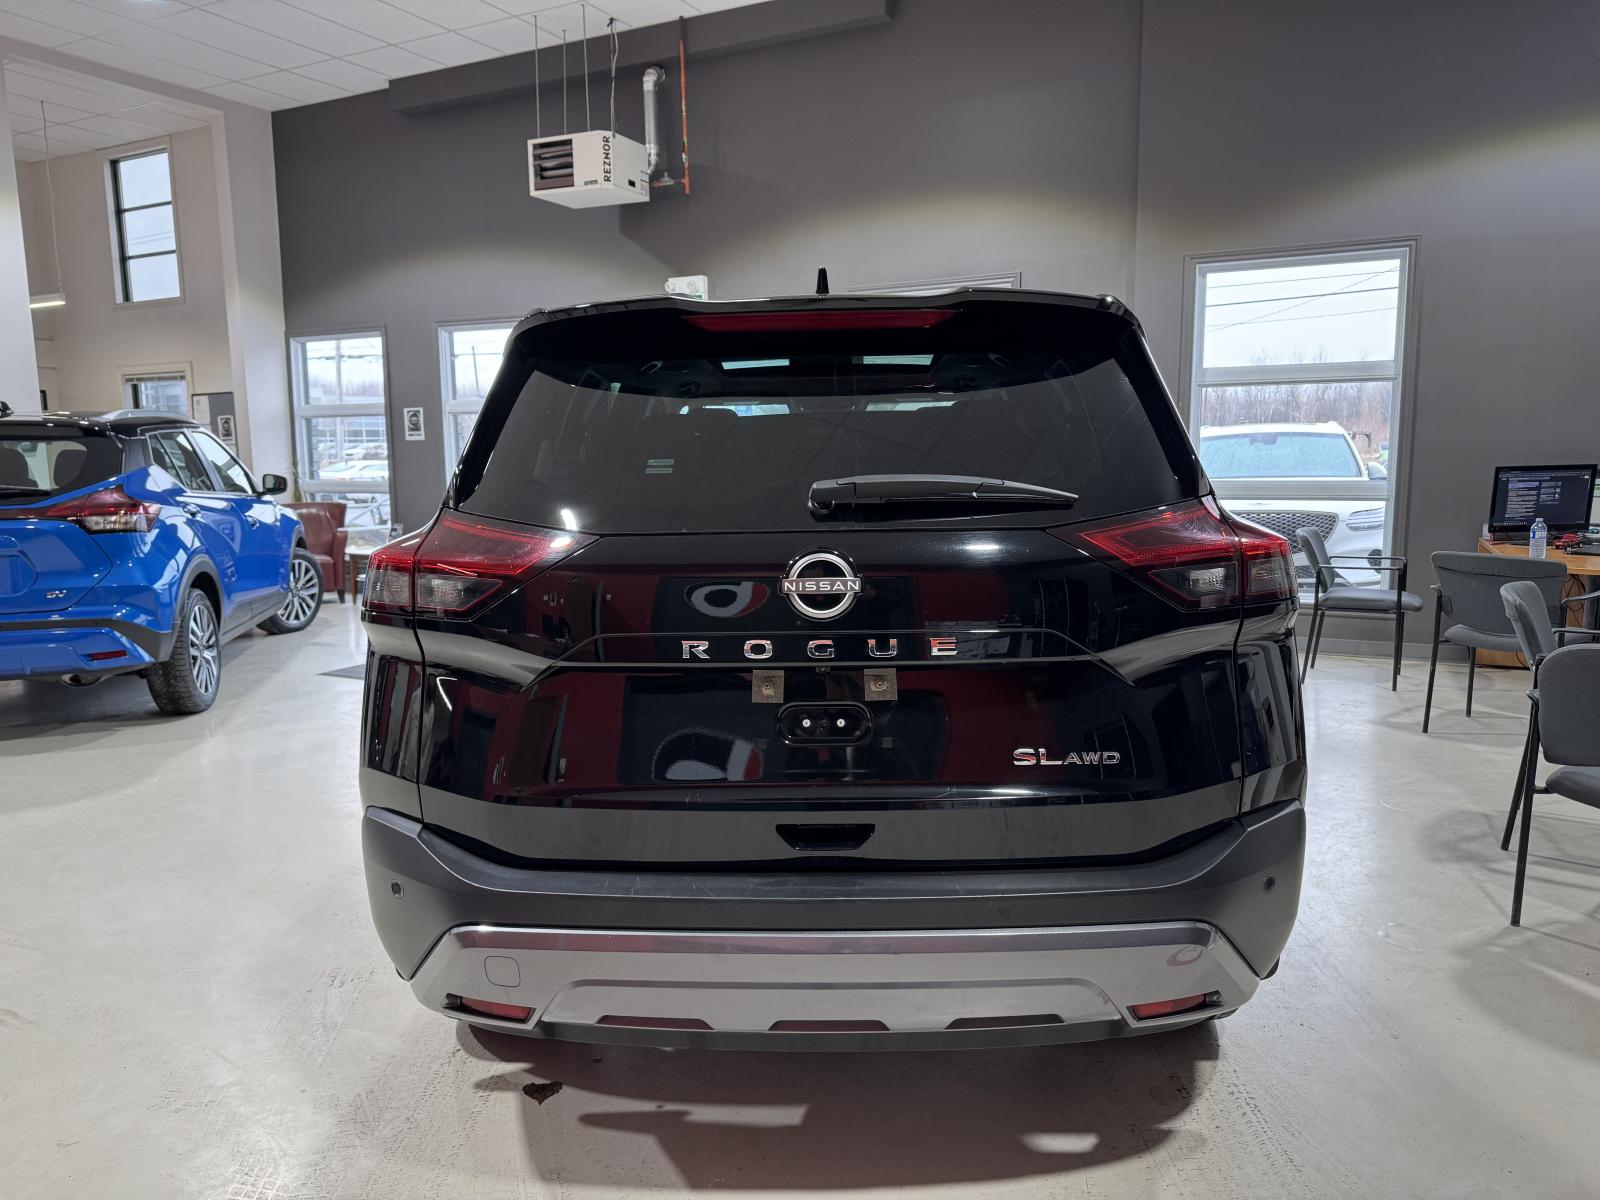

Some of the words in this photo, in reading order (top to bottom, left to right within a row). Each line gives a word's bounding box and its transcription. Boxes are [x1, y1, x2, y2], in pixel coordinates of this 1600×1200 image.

[602, 135, 612, 183] REZNOR
[784, 580, 860, 592] NISSAN
[681, 637, 958, 660] ROGUE
